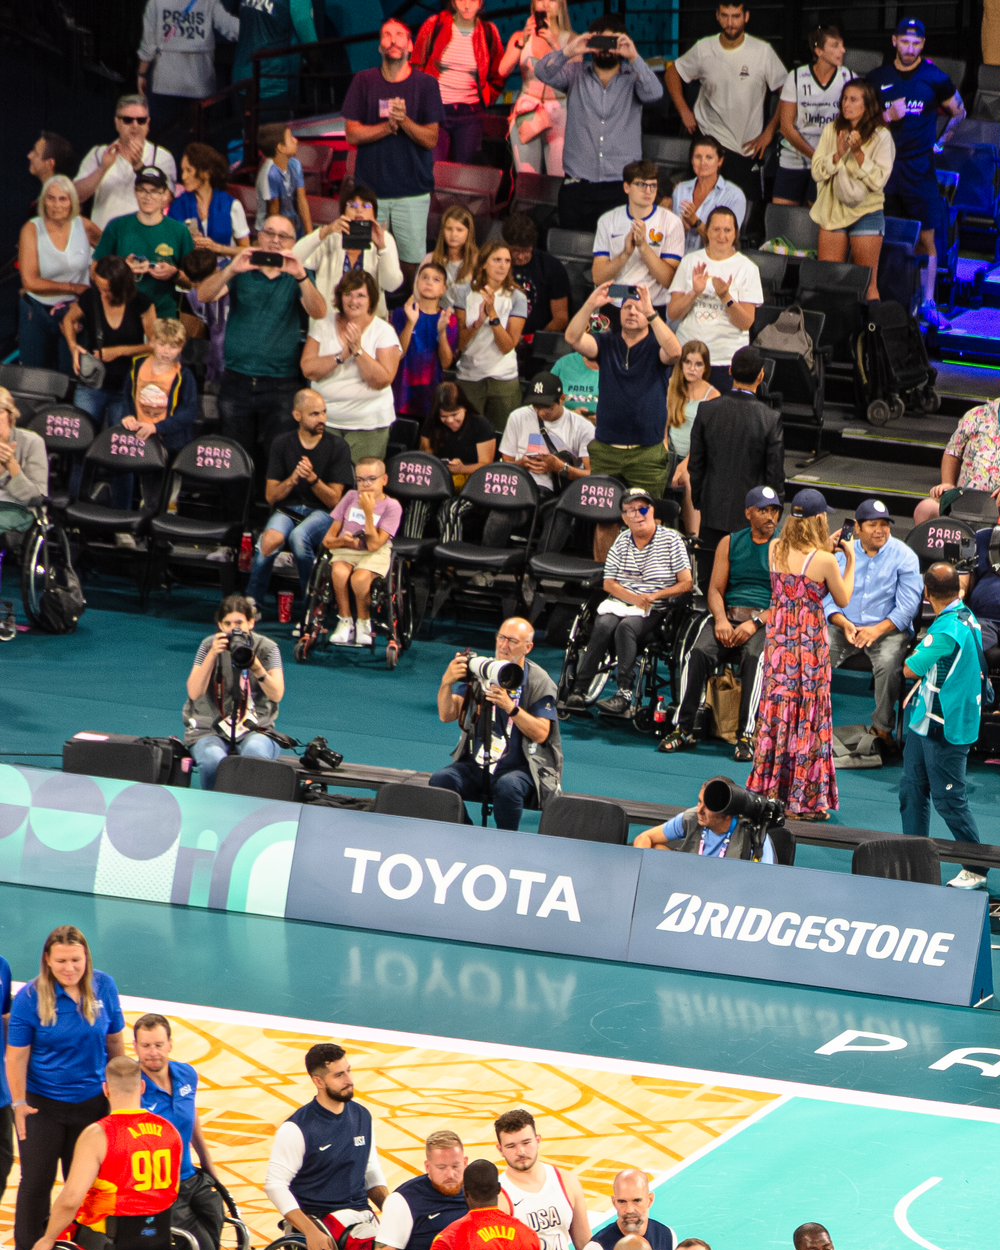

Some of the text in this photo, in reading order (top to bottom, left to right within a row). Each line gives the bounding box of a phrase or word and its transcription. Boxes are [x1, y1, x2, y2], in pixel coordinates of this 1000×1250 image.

[46, 425, 79, 439] 2024
[110, 444, 145, 458] 2024
[196, 456, 230, 469] 2024
[398, 473, 431, 486] 2024
[484, 483, 517, 496] 2024
[580, 495, 614, 509] 2024
[343, 847, 582, 923] TOYOTA
[656, 892, 955, 967] BRIDGESTONE
[131, 1148, 173, 1192] 90
[526, 1206, 561, 1232] USA
[477, 1225, 516, 1243] DIALLO
